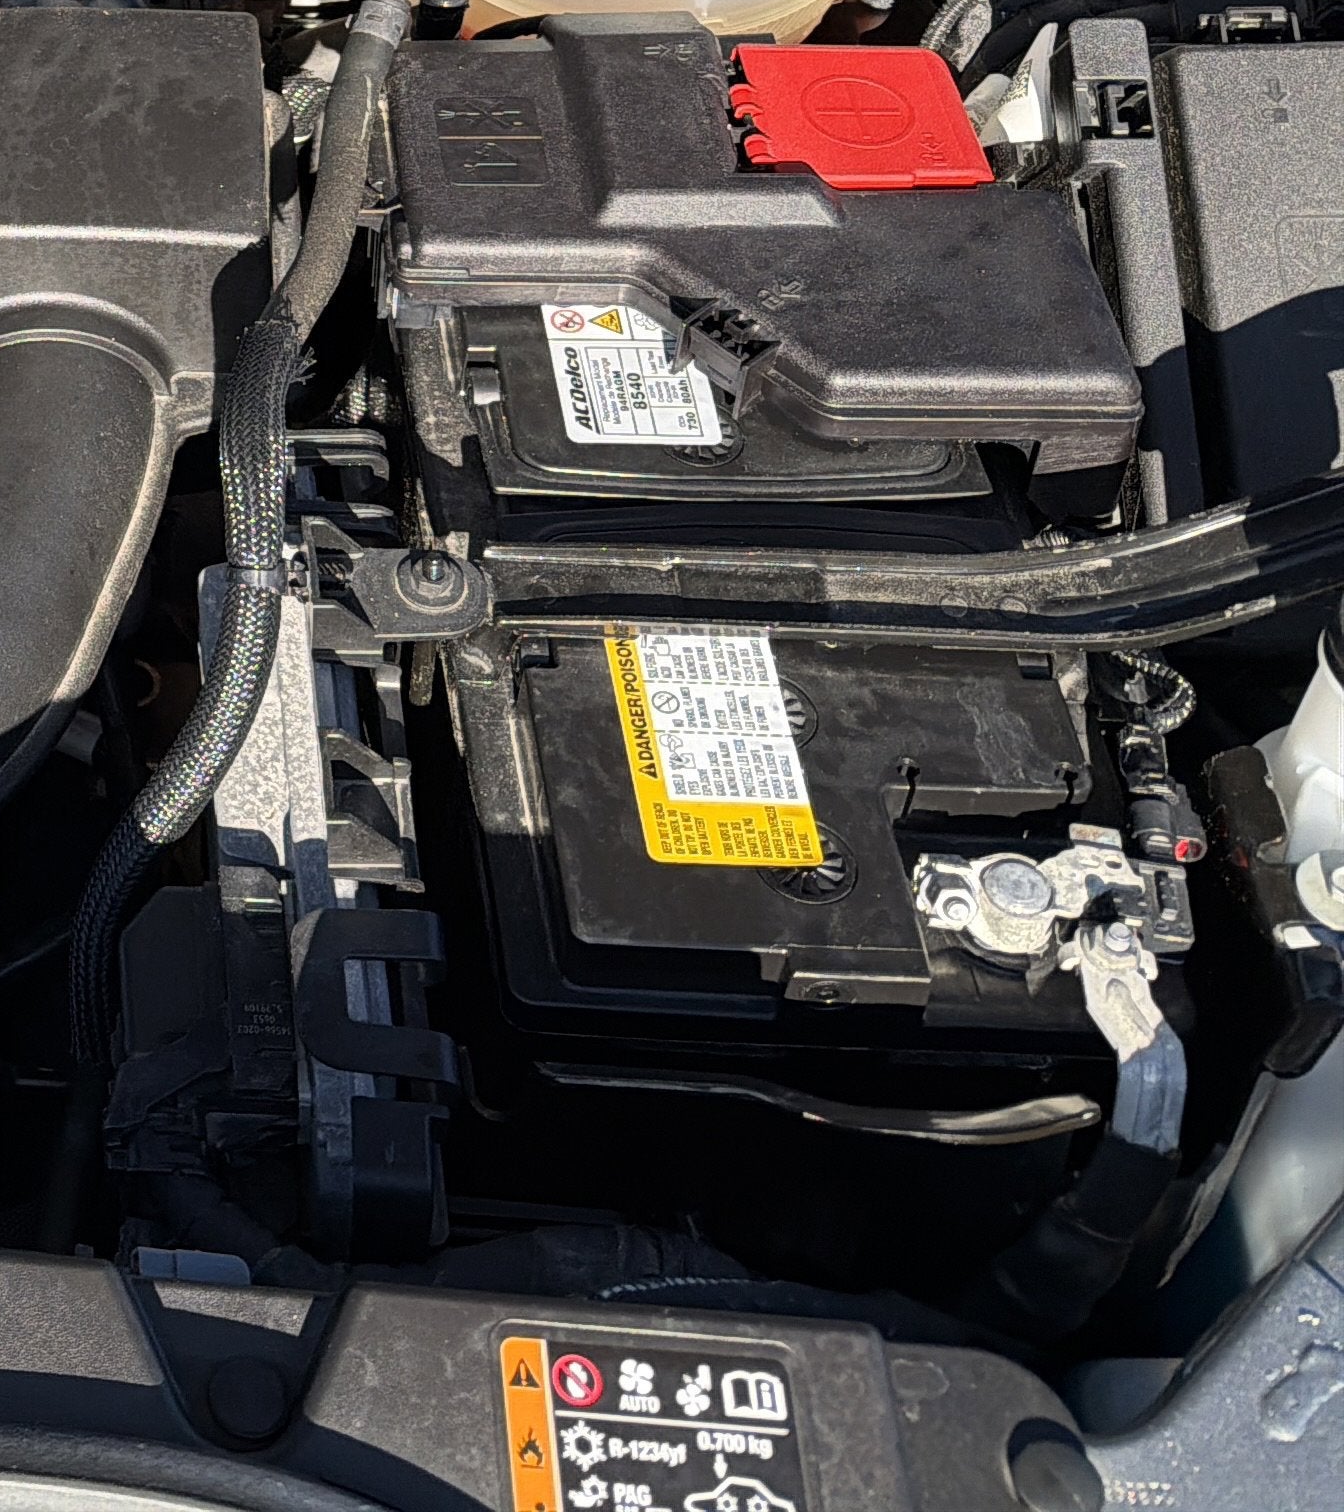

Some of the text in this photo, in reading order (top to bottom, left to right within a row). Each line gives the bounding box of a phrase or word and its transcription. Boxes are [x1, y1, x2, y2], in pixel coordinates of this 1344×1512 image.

[563, 346, 593, 431] ACDelco
[613, 370, 629, 412] 94RAGM
[627, 372, 648, 410] 8540
[680, 379, 692, 404] 80Ah
[685, 412, 698, 430] 730
[619, 1394, 660, 1413] AUTO
[608, 1438, 687, 1467] R-1234yf
[697, 1431, 773, 1460] 0.700 kg
[613, 1483, 652, 1507] PAG
